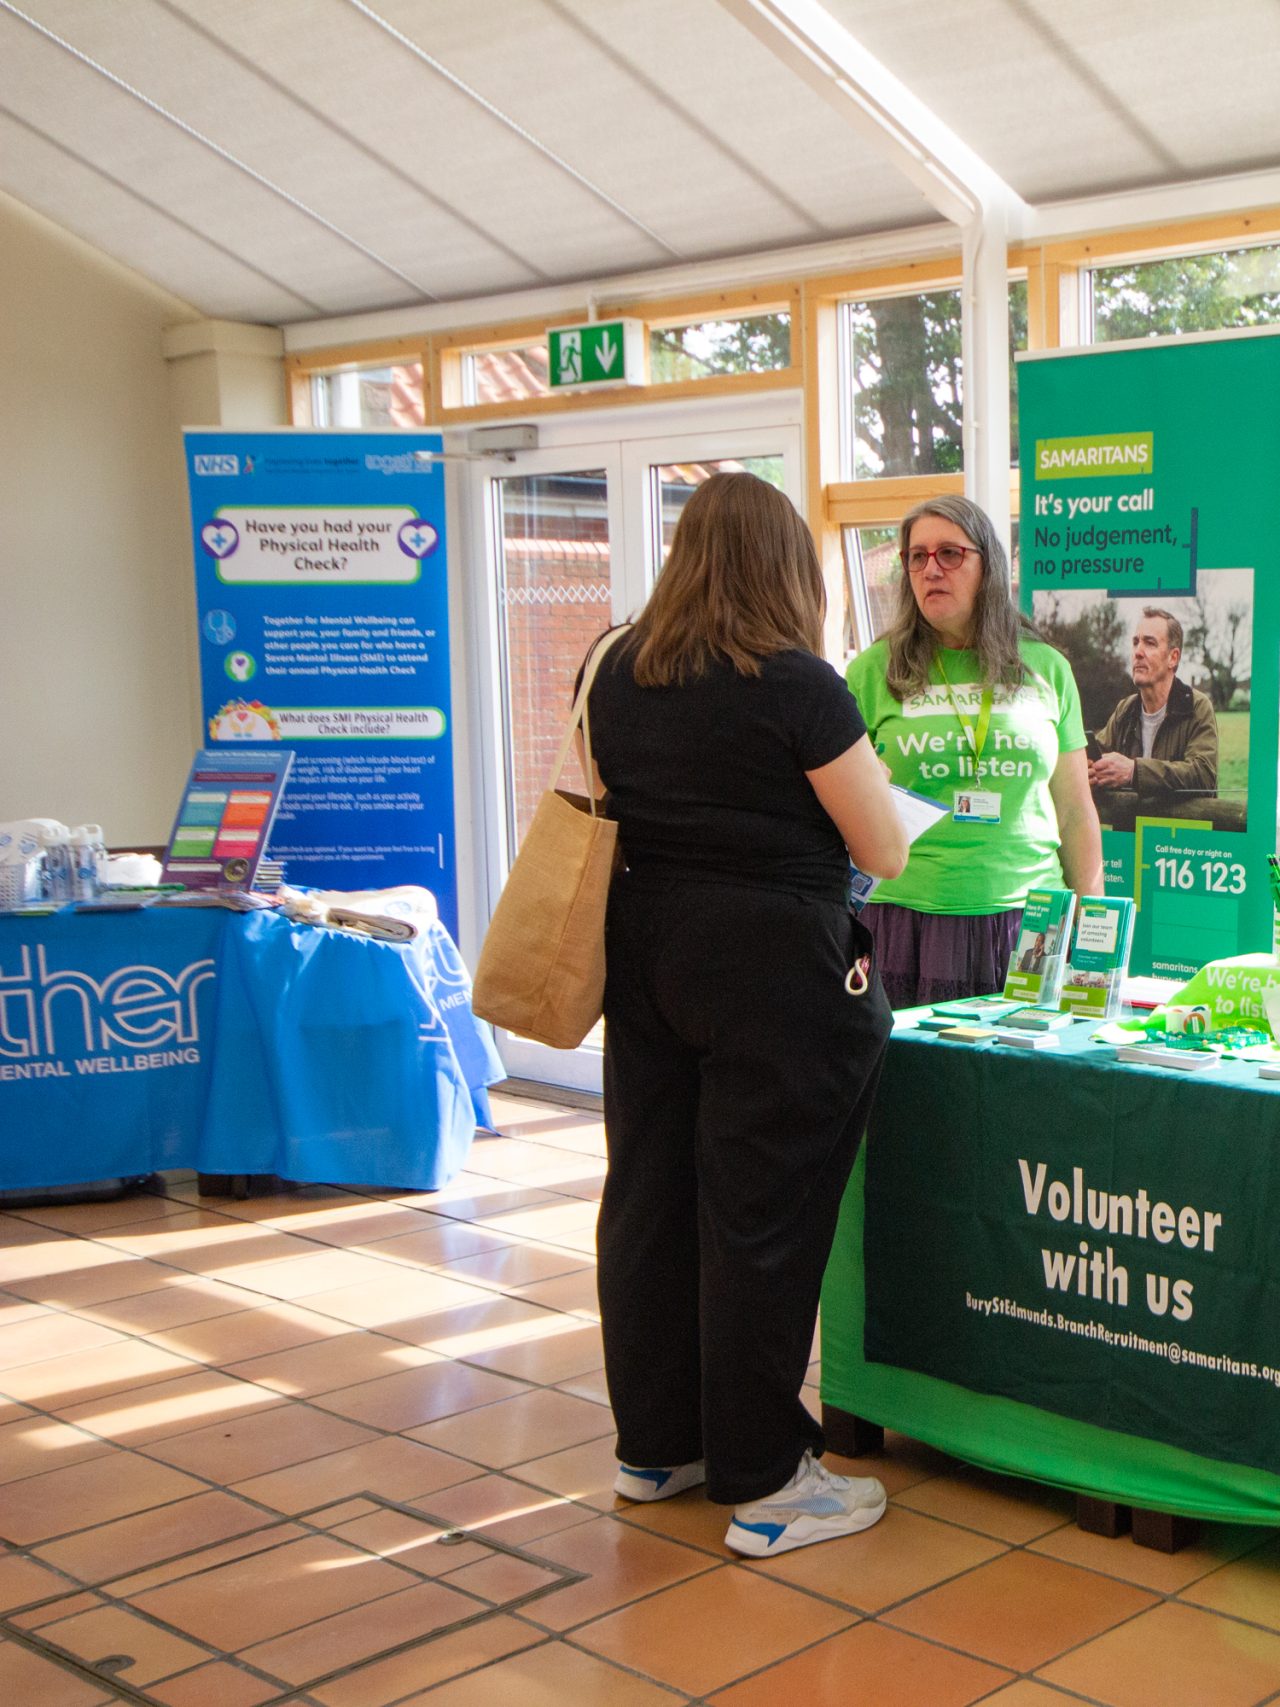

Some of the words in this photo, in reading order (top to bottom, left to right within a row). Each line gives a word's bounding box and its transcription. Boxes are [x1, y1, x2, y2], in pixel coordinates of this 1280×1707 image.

[1040, 444, 1149, 469] SAMARITANS
[1035, 493, 1063, 516] It's
[1067, 495, 1112, 519] your
[1117, 488, 1154, 512] call
[245, 520, 286, 533] Have
[290, 523, 318, 536] you
[323, 519, 352, 533] had
[357, 523, 391, 535] your
[1034, 527, 1061, 548] No
[1065, 524, 1177, 551] judgement,
[260, 538, 323, 554] Physical
[328, 538, 379, 551] Health
[294, 557, 348, 571] Check?
[1033, 558, 1056, 575] no
[1061, 556, 1145, 579] pressure
[279, 713, 305, 723] What
[307, 714, 330, 723] does
[332, 712, 351, 723] SMI
[354, 713, 393, 724] Physical
[396, 713, 428, 723] Health
[318, 724, 348, 734] Check
[350, 724, 390, 734] include?
[919, 761, 950, 779] to
[958, 756, 1033, 778] listen
[1155, 844, 1168, 853] Call
[1169, 845, 1182, 854] free
[1182, 847, 1196, 856] day
[1204, 849, 1222, 859] night
[1154, 857, 1195, 890] 116
[1201, 861, 1247, 895] 123
[1206, 966, 1261, 992] We're
[1215, 995, 1234, 1015] to
[75, 1047, 200, 1075] WELLBEING
[1017, 1158, 1222, 1252] Volunteer
[1041, 1241, 1128, 1307] with
[1146, 1273, 1194, 1321] us
